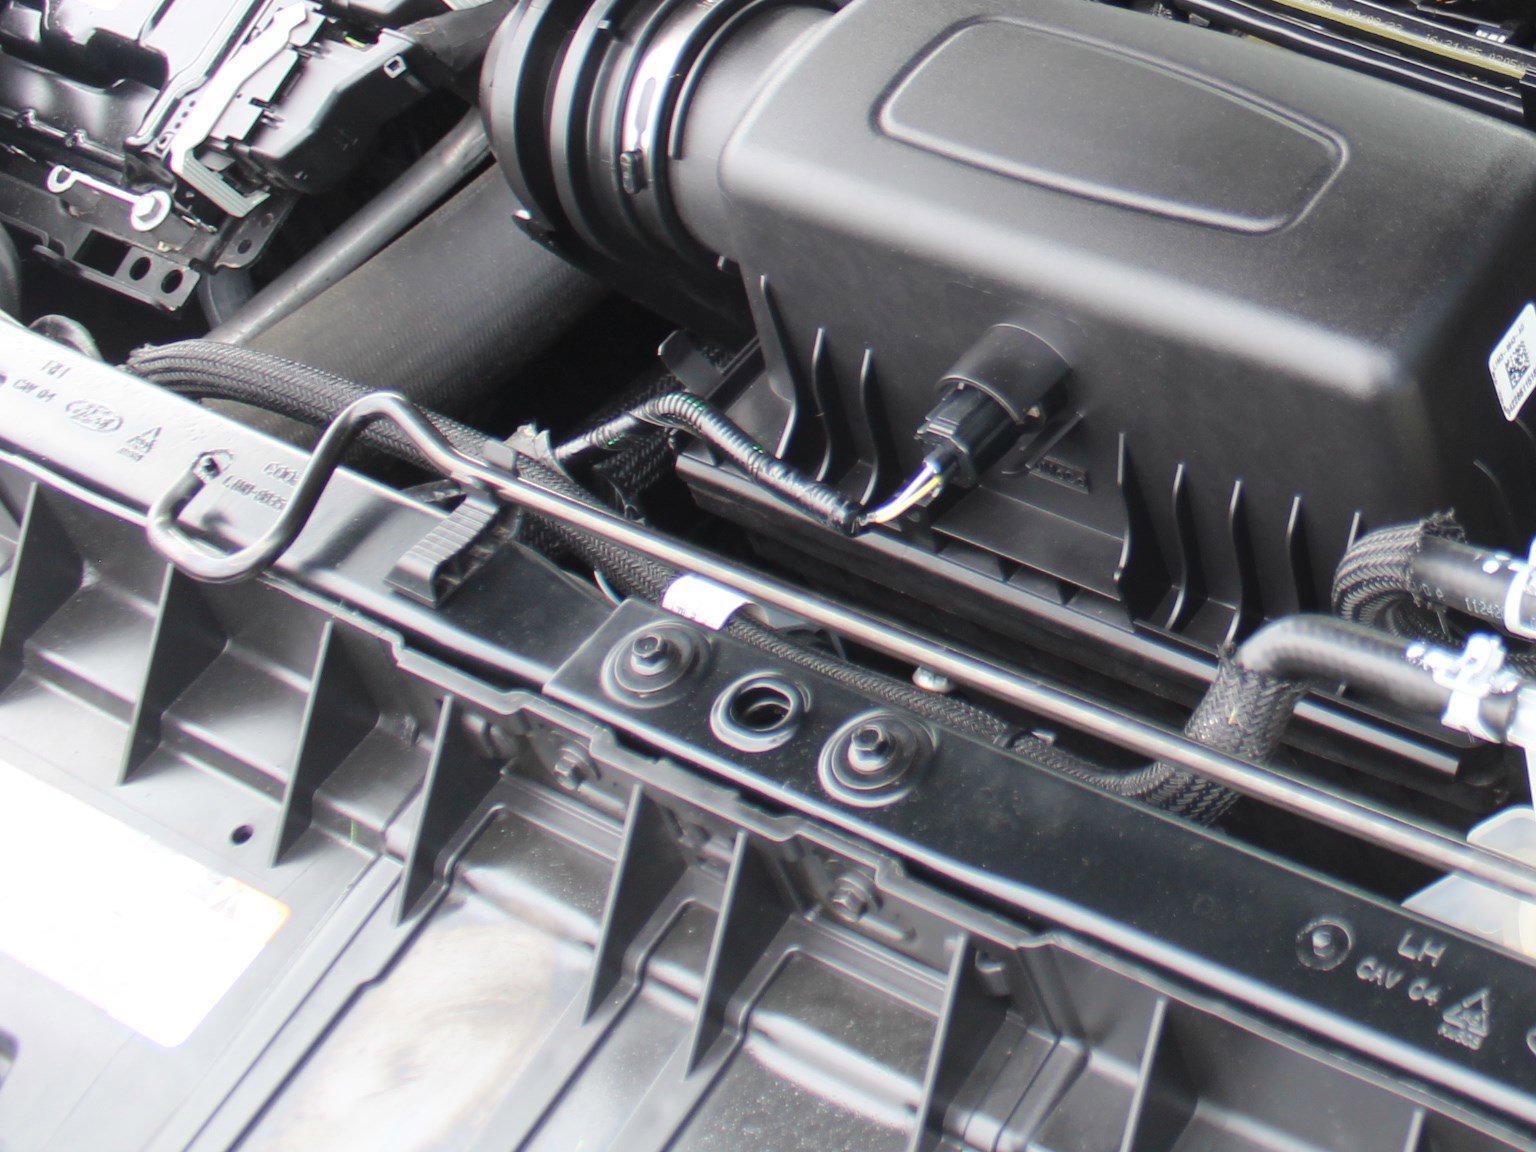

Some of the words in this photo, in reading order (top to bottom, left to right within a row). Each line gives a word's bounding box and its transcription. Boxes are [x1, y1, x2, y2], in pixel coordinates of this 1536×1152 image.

[1397, 929, 1448, 968] LH
[1355, 956, 1405, 990] CAV
[1407, 977, 1443, 1006] 04
